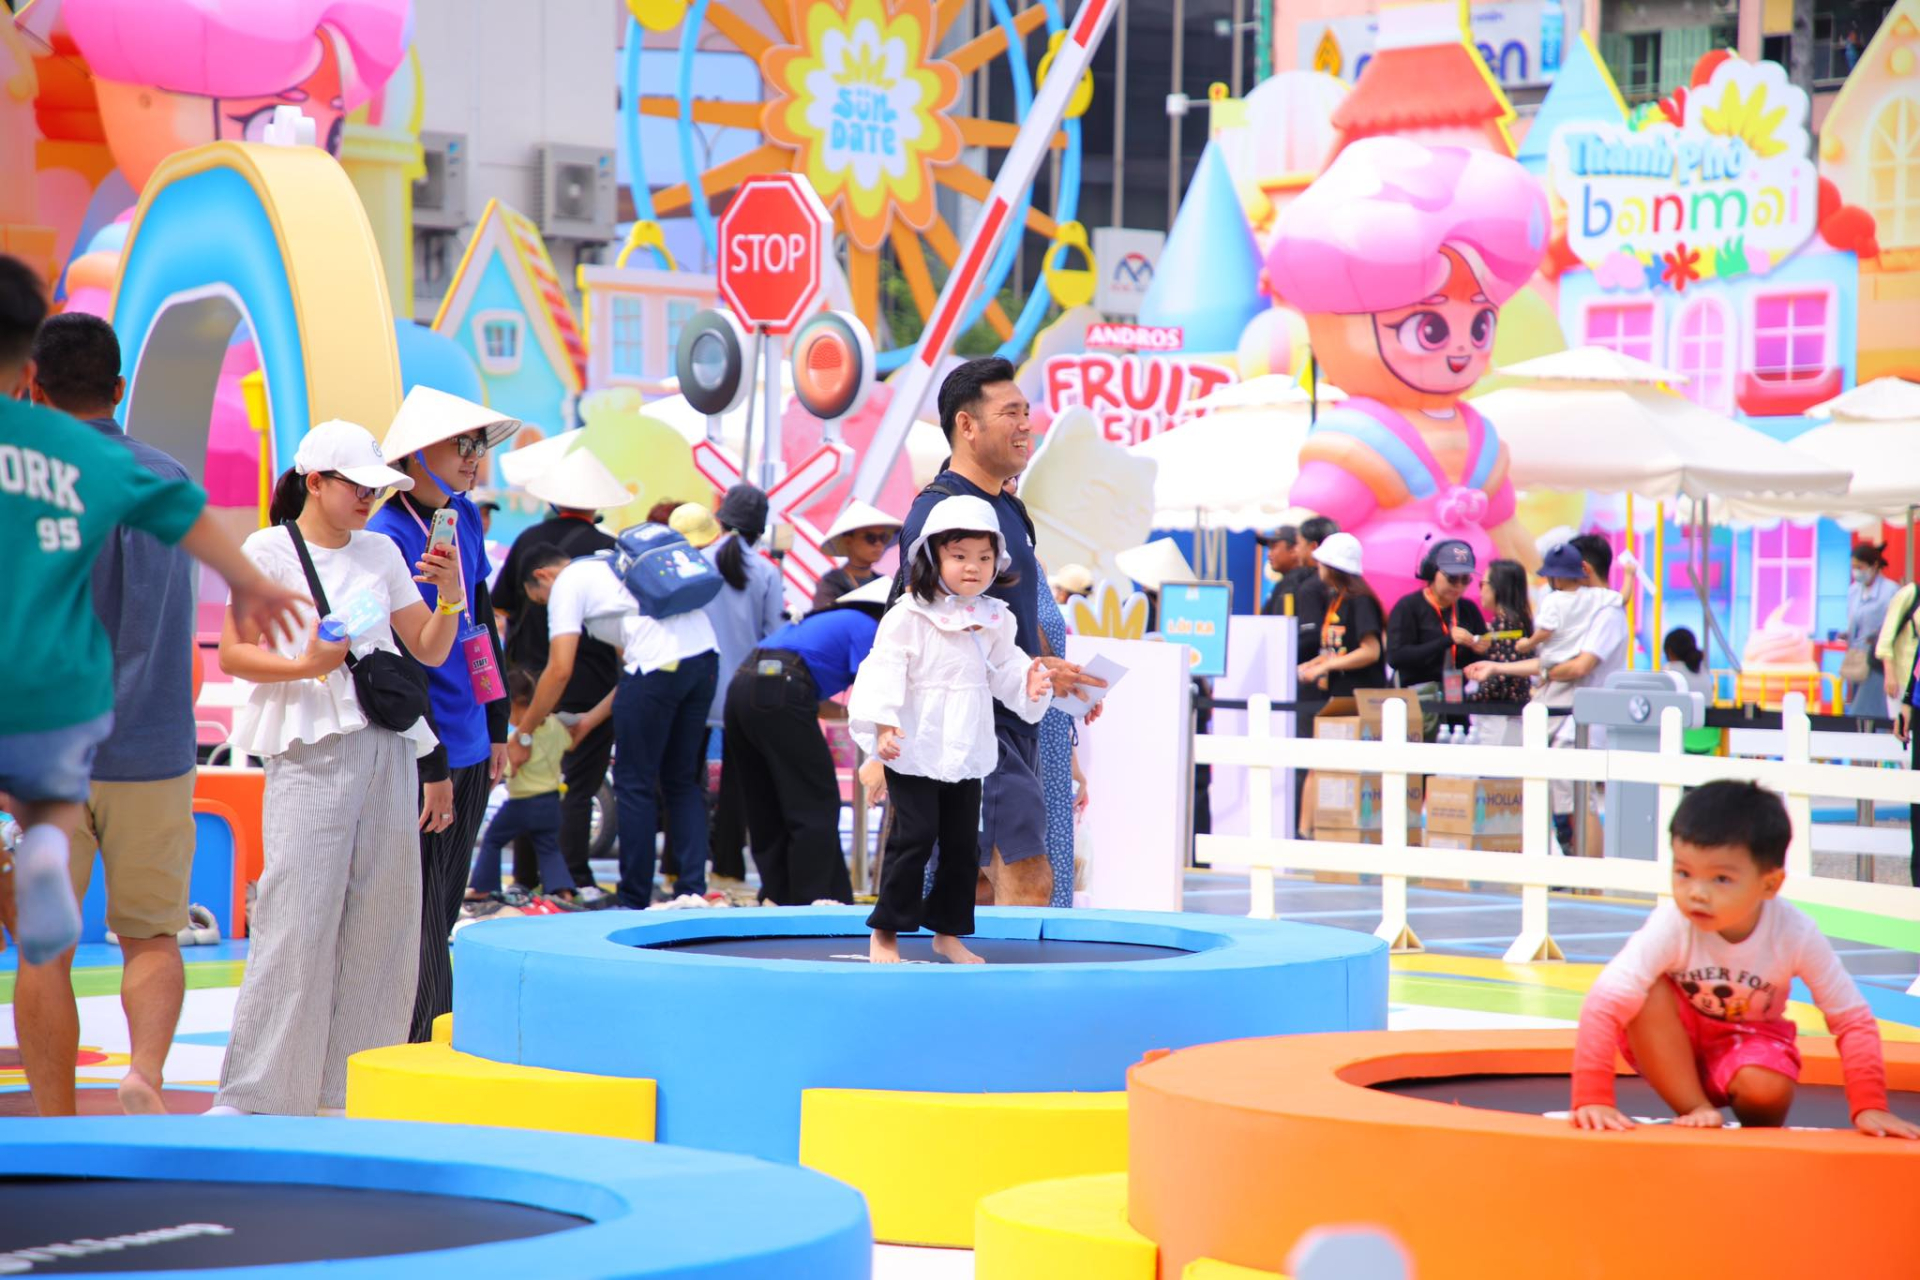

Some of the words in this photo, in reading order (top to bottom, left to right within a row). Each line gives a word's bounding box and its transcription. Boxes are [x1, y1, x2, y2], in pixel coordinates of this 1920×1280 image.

[1582, 167, 1799, 237] banmai
[731, 233, 806, 273] STOP
[1087, 326, 1181, 347] ANDROS
[1046, 356, 1231, 417] FRUIT
[36, 518, 81, 552] 95
